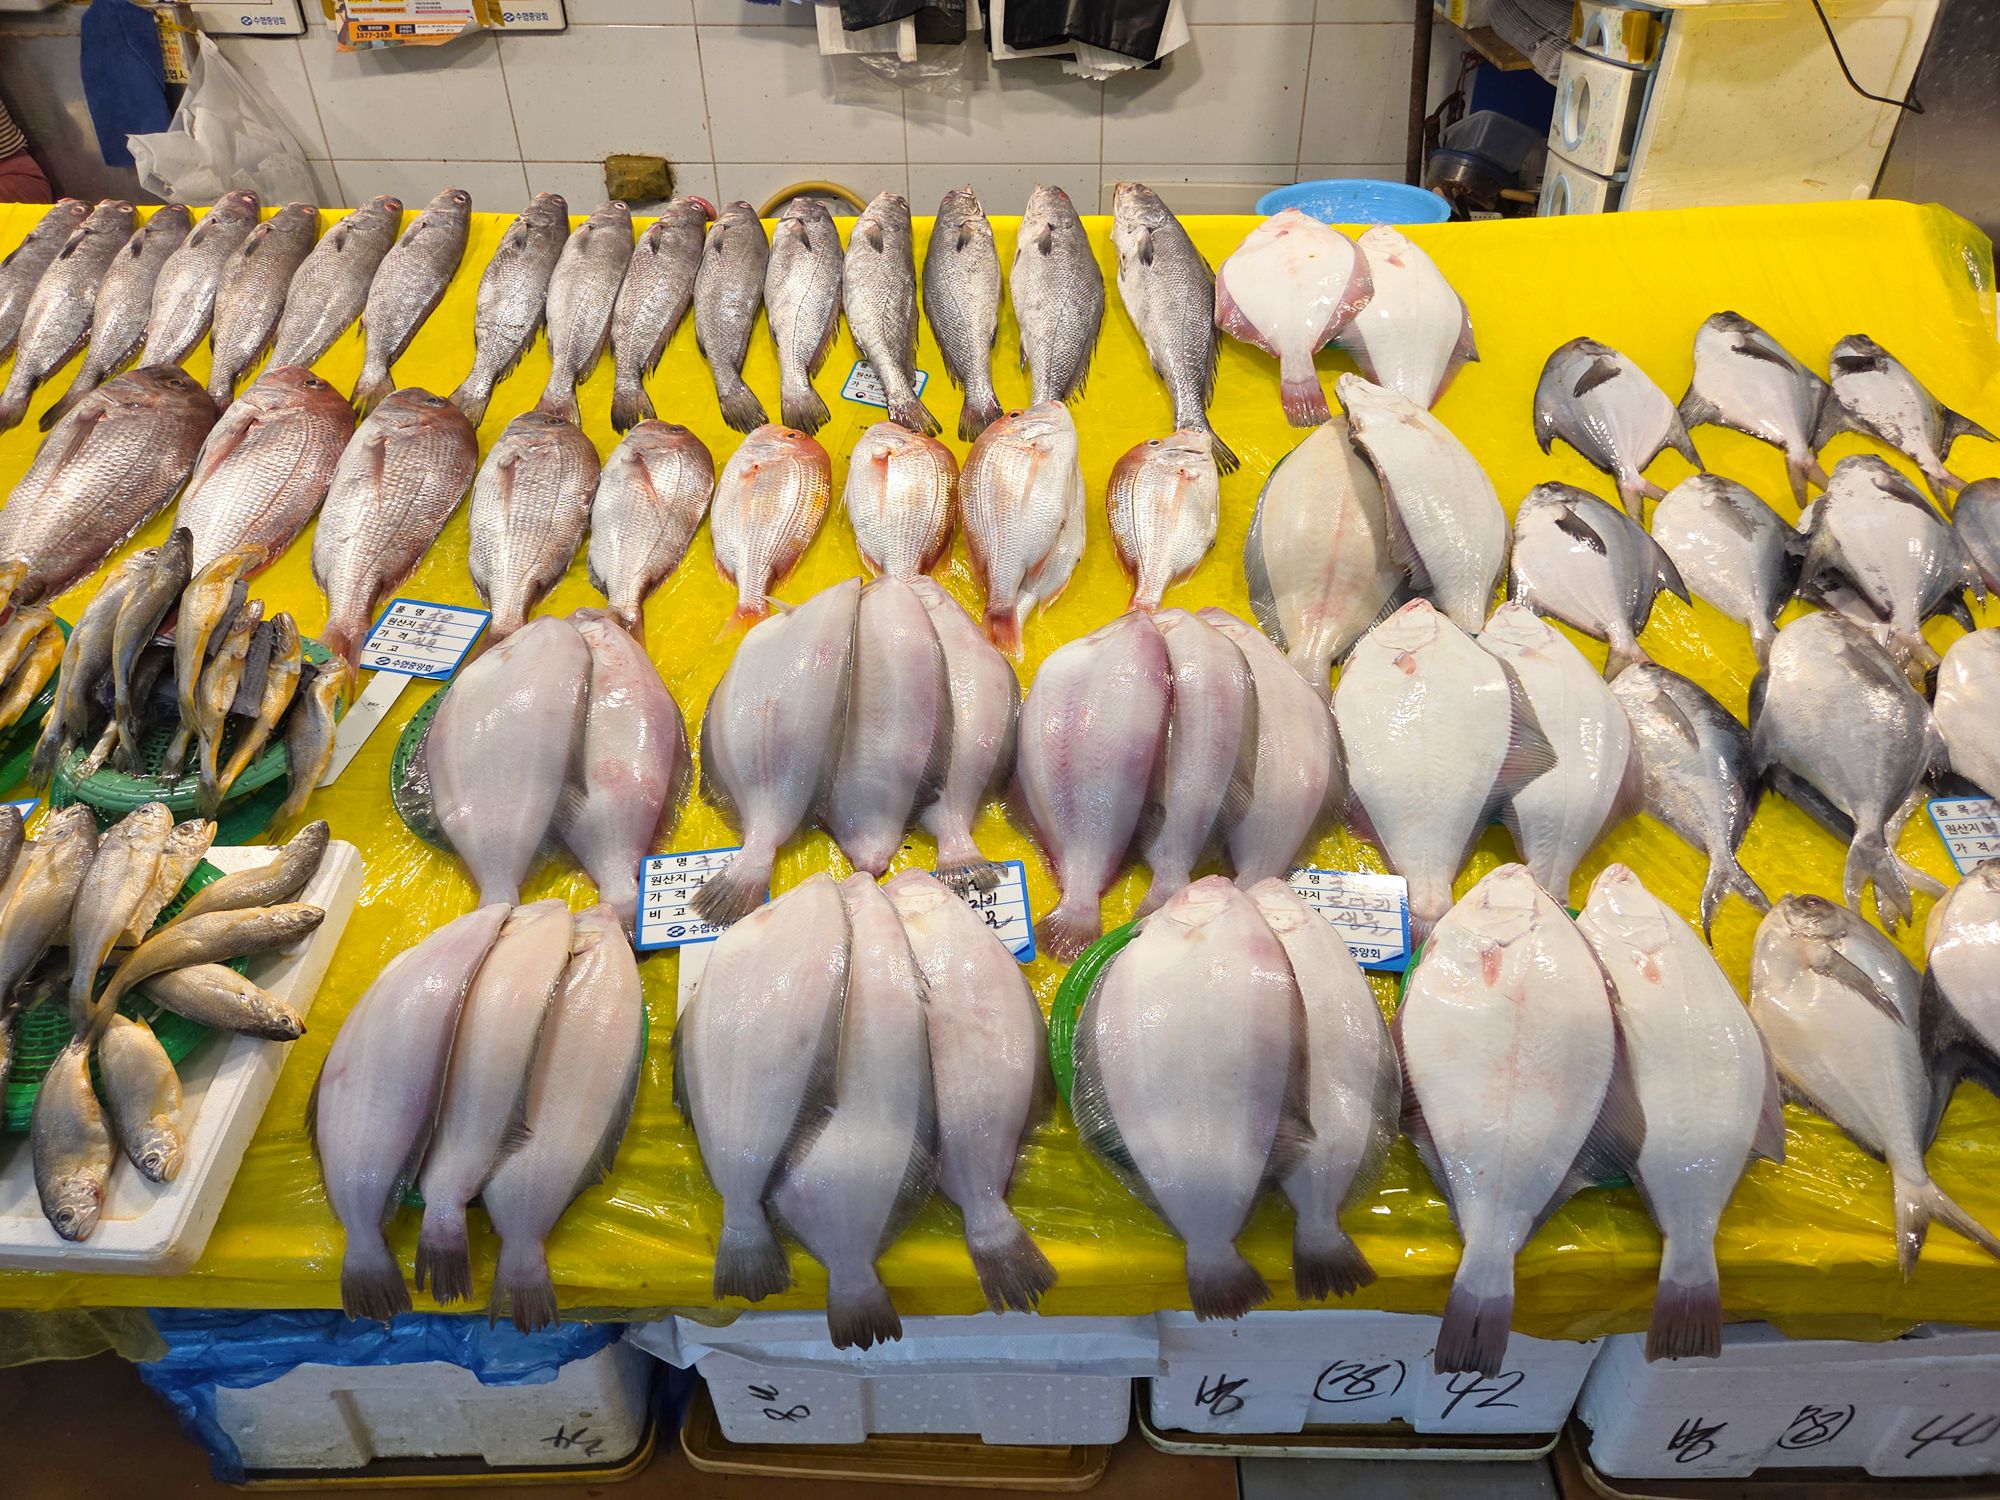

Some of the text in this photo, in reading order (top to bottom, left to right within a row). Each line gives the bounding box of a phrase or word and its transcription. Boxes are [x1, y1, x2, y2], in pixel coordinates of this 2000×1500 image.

[254, 16, 286, 25] 수협중앙회
[516, 12, 549, 21] 수협중앙회
[387, 617, 416, 628] 원산지
[392, 660, 434, 672] 수협중앙회
[1945, 823, 1981, 835] 원산지
[651, 873, 687, 886] 원산지
[1440, 1370, 1525, 1420] 42
